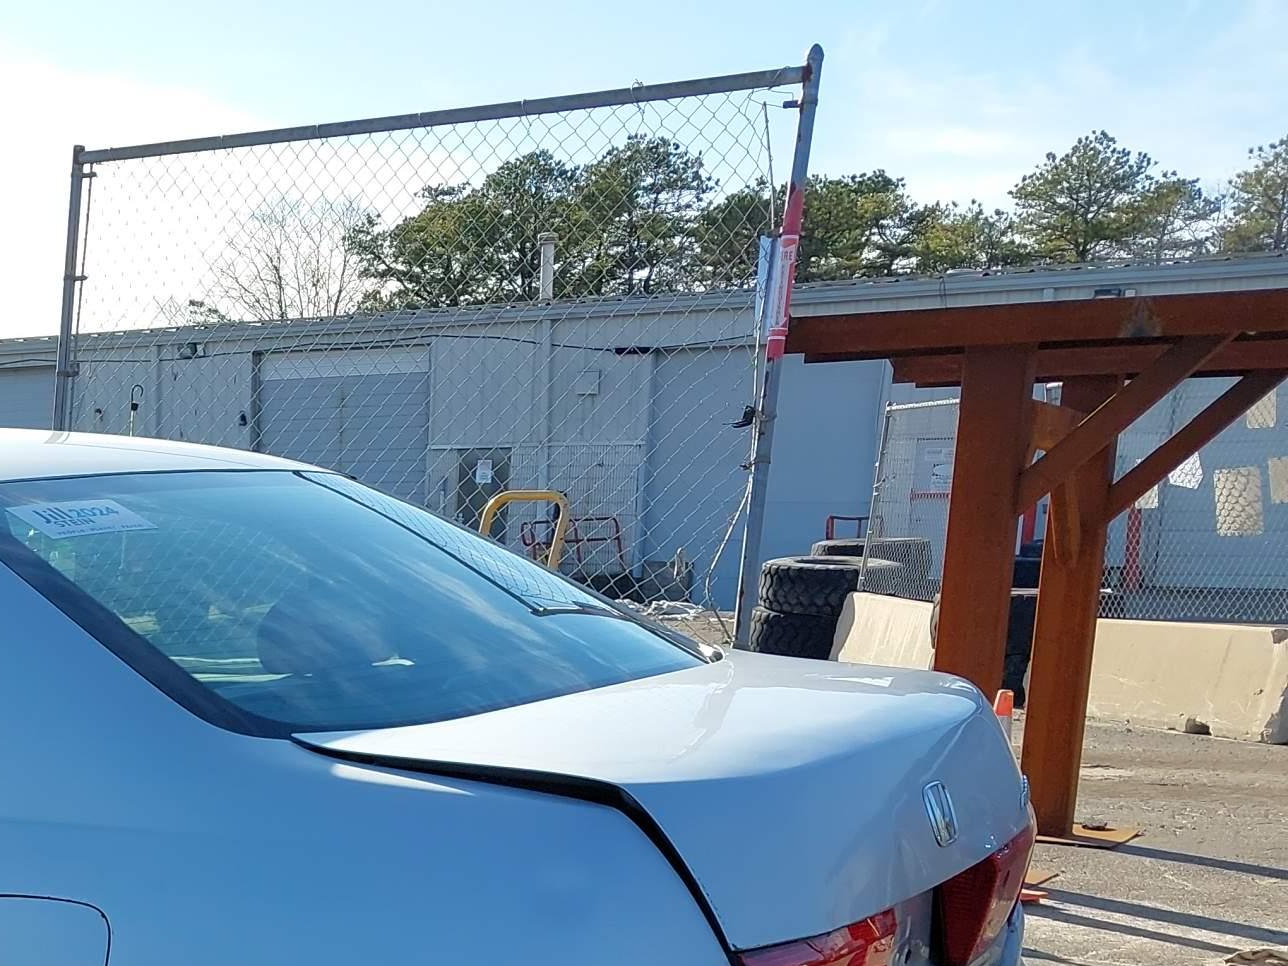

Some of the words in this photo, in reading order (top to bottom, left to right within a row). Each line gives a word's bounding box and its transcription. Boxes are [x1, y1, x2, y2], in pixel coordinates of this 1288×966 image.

[31, 507, 73, 524] Jill
[70, 506, 119, 519] 2024
[53, 518, 96, 528] STEIN
